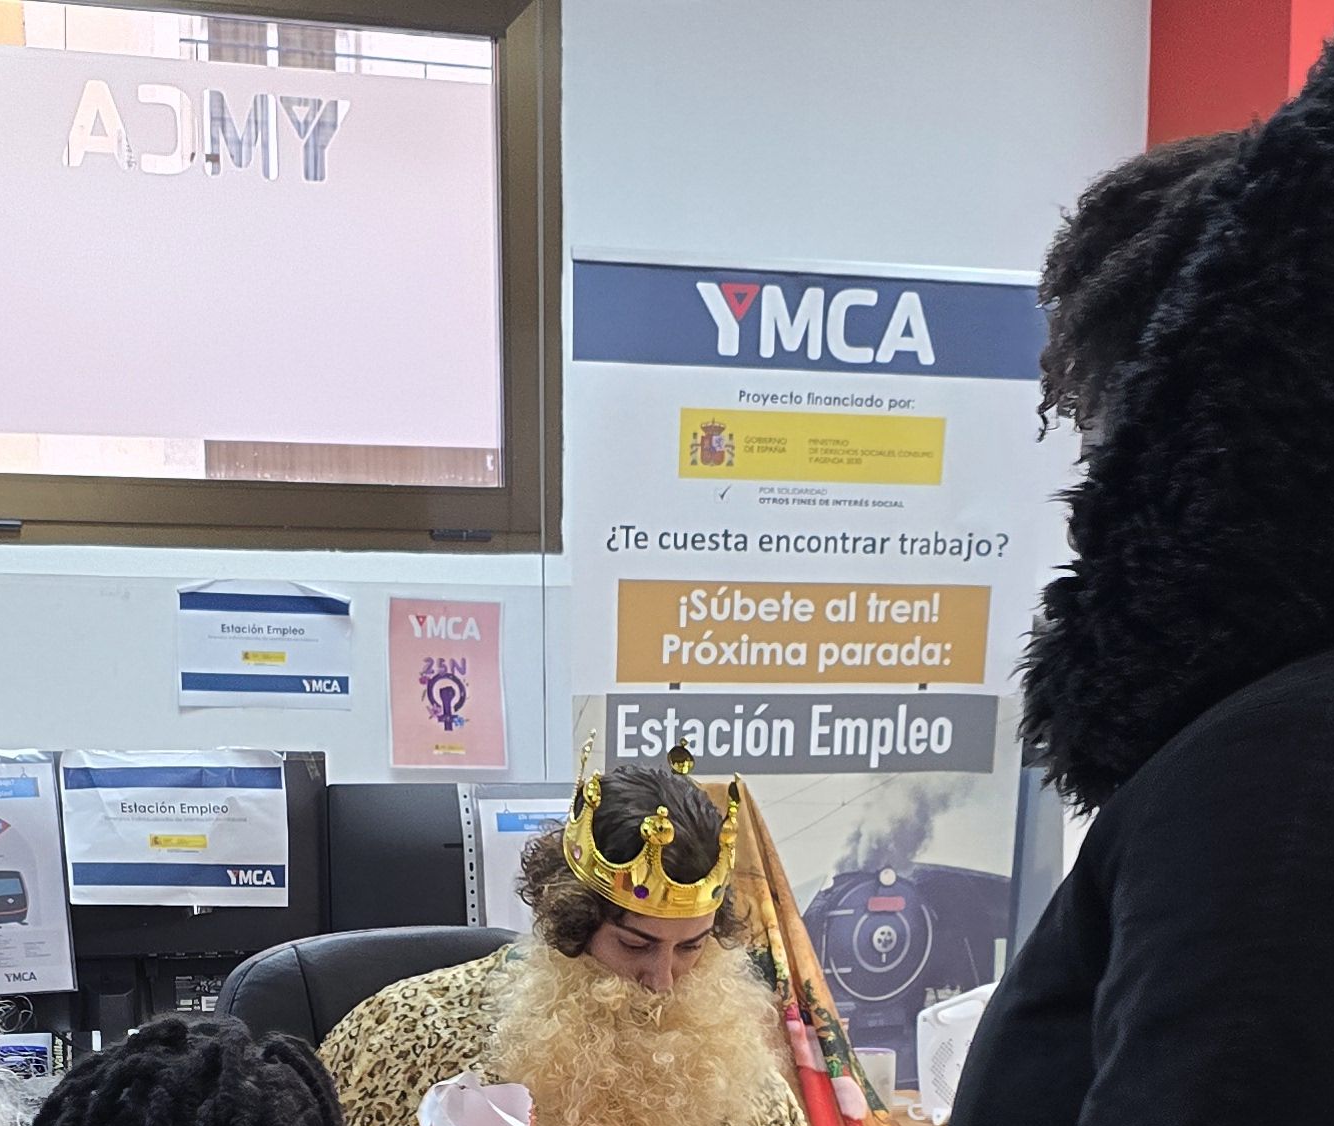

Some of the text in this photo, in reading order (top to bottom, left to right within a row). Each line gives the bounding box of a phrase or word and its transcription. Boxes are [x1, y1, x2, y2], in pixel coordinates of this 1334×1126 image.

[696, 281, 936, 366] YMCA
[738, 389, 917, 411] Proyecto financiado por:
[758, 496, 905, 509] OTROS FINES DE INTERÉS SOCIAL
[606, 525, 1010, 562] ¿Te cuesta encontrar trabajo?
[679, 585, 940, 628] ¡Súbete al tren!
[220, 623, 305, 637] Estación Empleo
[408, 614, 482, 641] YMCA
[662, 629, 953, 674] Próxima parada:
[422, 656, 467, 676] 25N
[302, 678, 342, 693] YMCA
[616, 702, 953, 769] Estación Empleo
[120, 801, 229, 817] Estación Empleo
[226, 868, 276, 886] YMCA
[4, 971, 38, 983] YMCA
